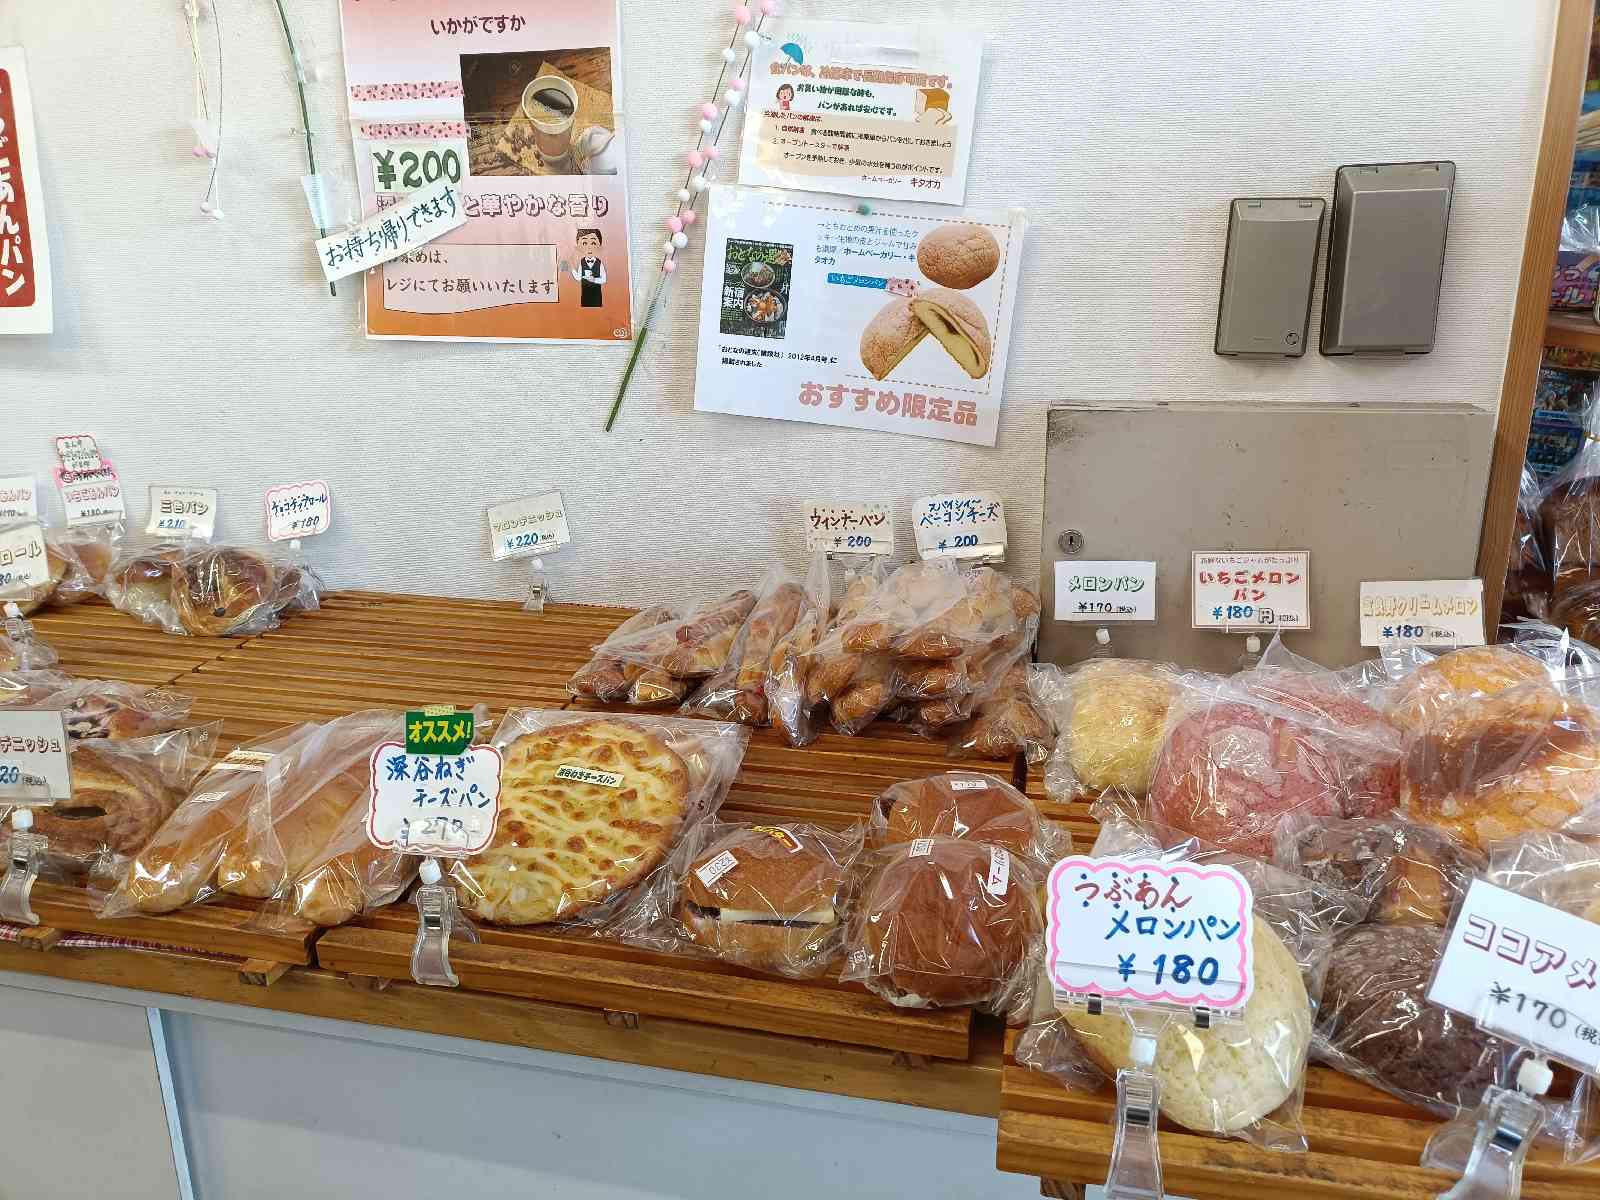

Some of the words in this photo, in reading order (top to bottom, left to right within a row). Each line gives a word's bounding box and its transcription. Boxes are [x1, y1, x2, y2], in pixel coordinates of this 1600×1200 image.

[430, 15, 527, 35] いかがですか
[817, 101, 897, 117] パンがあれば安心です。
[373, 148, 461, 191] ¥200
[910, 178, 941, 190] キタオカ
[463, 194, 609, 218] と華やかな香り
[326, 187, 457, 267] お持ち帰りできます
[389, 250, 449, 264] 求めは、
[387, 278, 555, 295] レジにてお願いいたします
[798, 381, 978, 427] おすすめ限定品
[160, 499, 209, 516] 三色パン
[506, 532, 539, 550] ¥220
[1068, 576, 1145, 592] メロンパン
[1199, 570, 1301, 585] いちごメロン
[1233, 587, 1266, 602] パン
[1078, 602, 1113, 613] ¥170
[1212, 605, 1255, 621] ¥180
[1258, 607, 1275, 624] 円
[1382, 624, 1424, 638] ¥180
[385, 754, 476, 781] 深谷ねぎ
[413, 783, 491, 809] チーズパン
[1073, 876, 1193, 910] つぶあん
[1104, 910, 1241, 941] メロンパン
[1118, 953, 1219, 985] ¥180
[1489, 981, 1567, 1029] ¥170
[1575, 1023, 1600, 1045] (税
